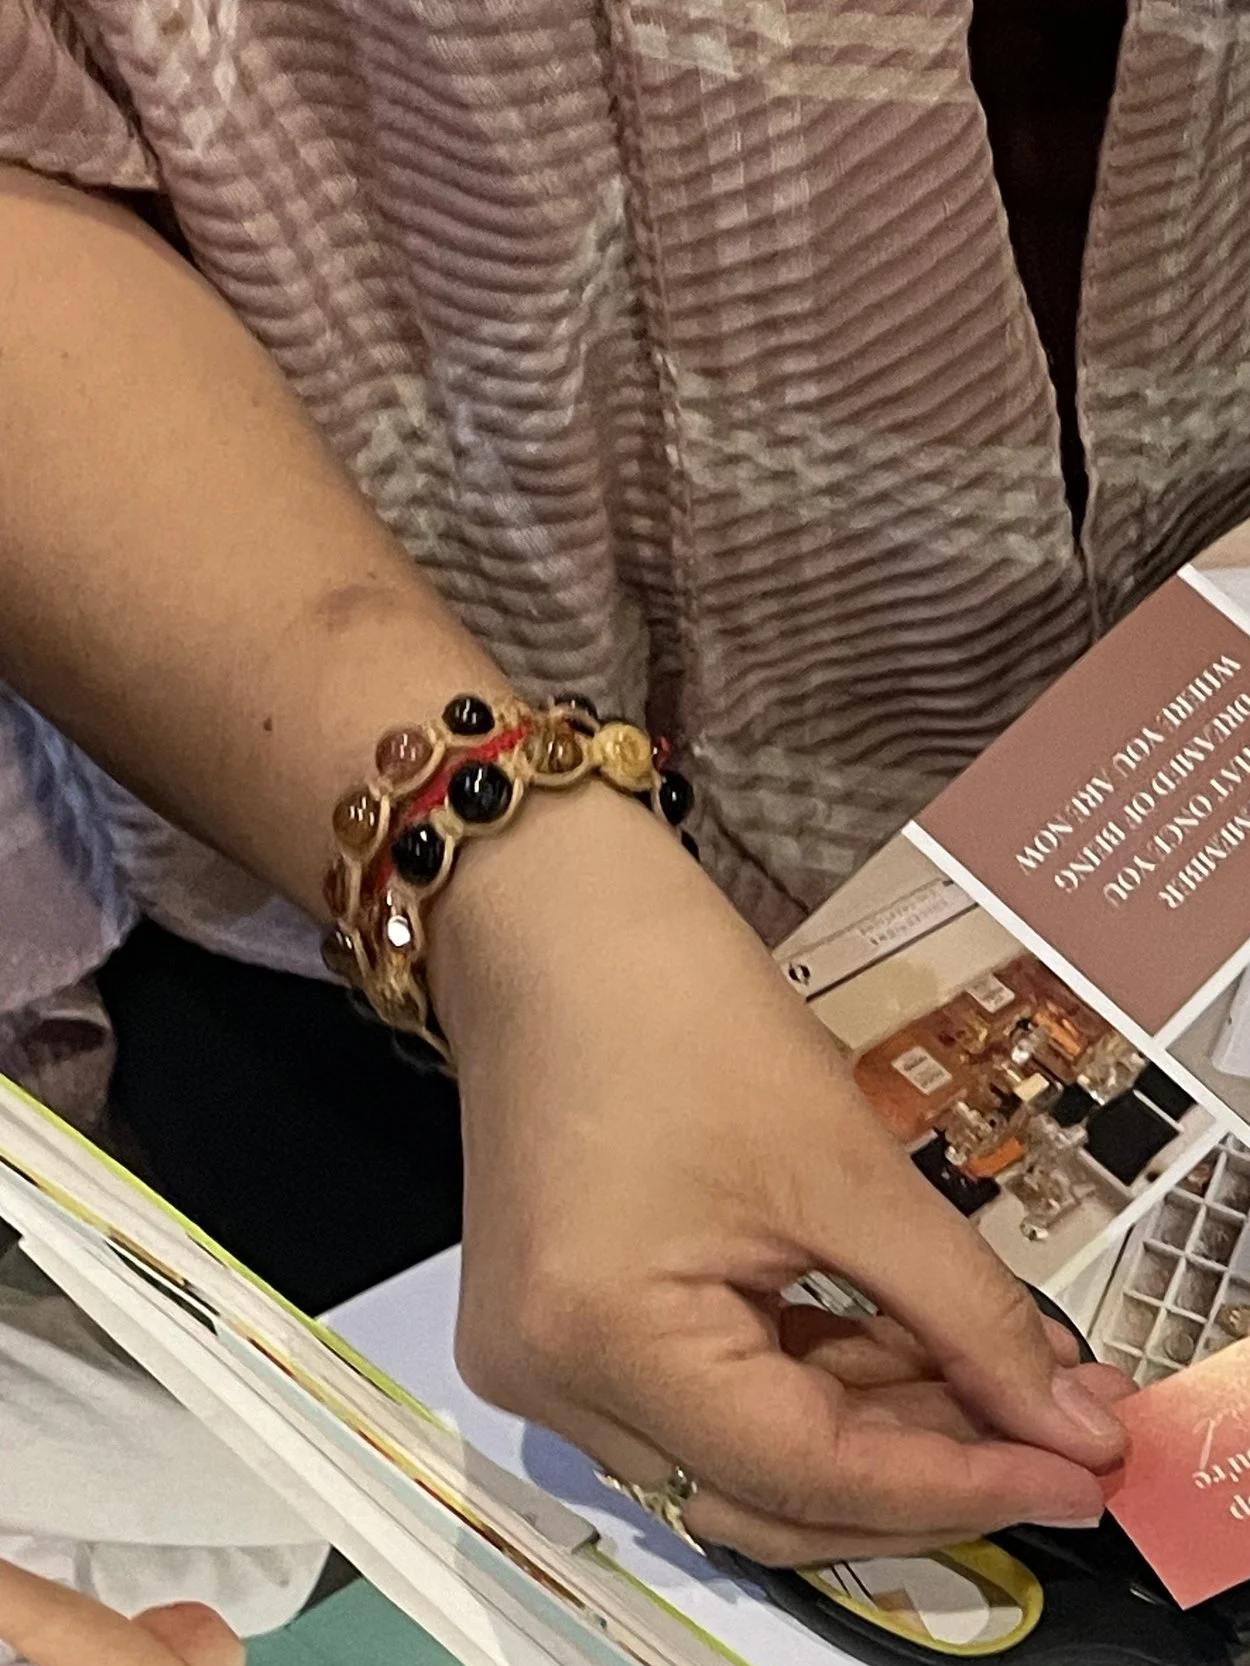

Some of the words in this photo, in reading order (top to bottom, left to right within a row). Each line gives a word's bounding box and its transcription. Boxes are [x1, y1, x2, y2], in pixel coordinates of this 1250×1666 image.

[1157, 656, 1240, 726] WHERE
[1113, 728, 1164, 776] YOU
[1066, 778, 1113, 822] ARE
[1124, 792, 1154, 828] OF
[1016, 824, 1072, 868] NOW
[1154, 796, 1212, 854] ONCE
[1055, 822, 1125, 892] BEING
[1104, 856, 1156, 904] YOU
